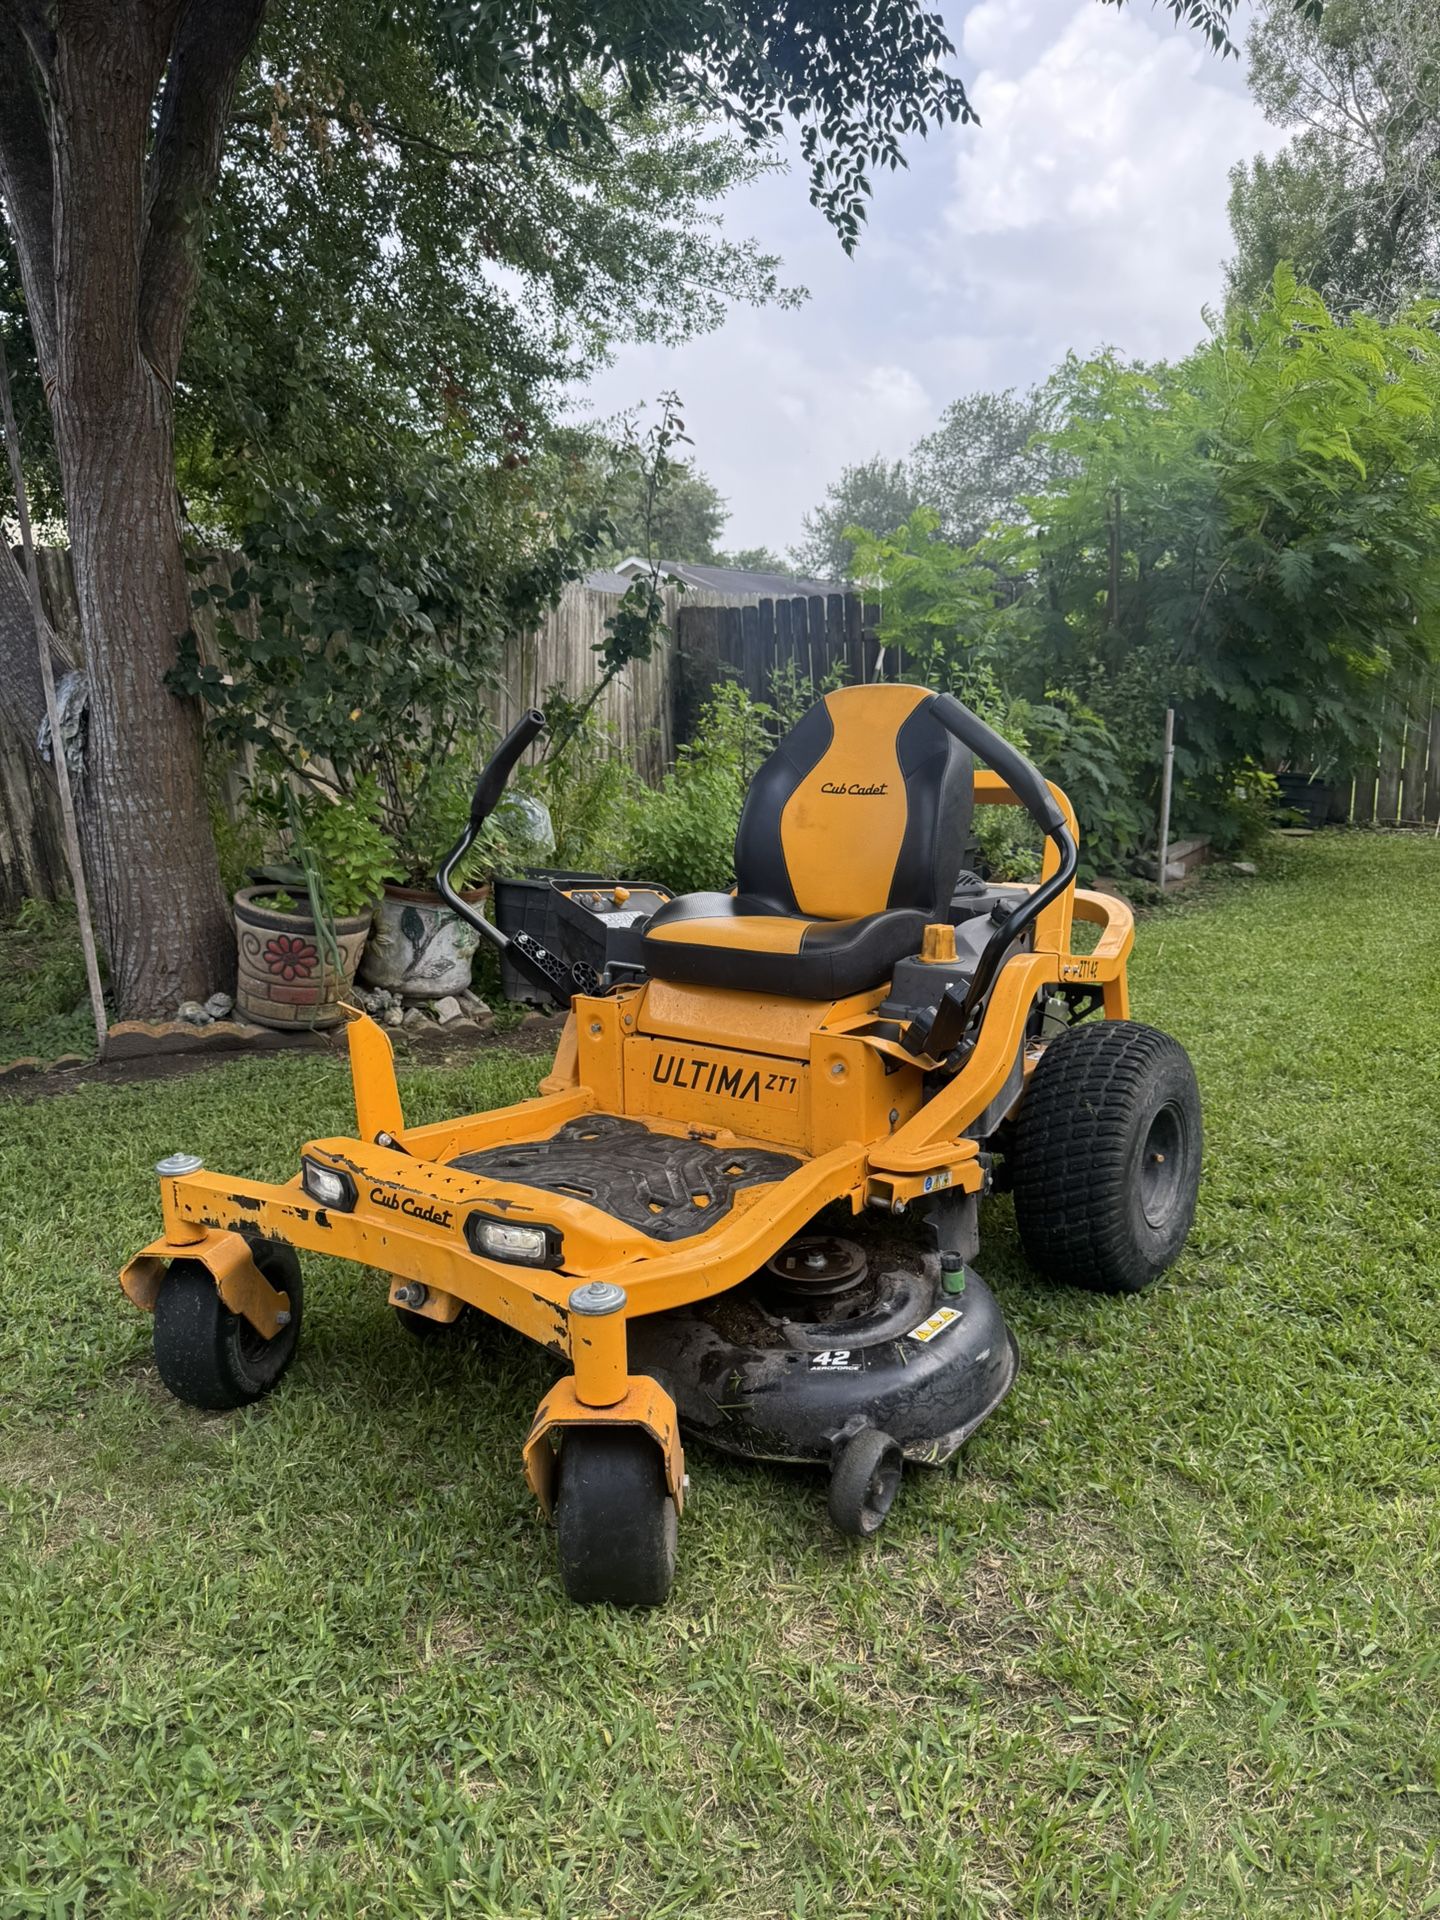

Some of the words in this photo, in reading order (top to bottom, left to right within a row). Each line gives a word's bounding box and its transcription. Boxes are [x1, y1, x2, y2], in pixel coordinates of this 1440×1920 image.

[821, 782, 847, 795] Cub
[847, 783, 888, 795] Cadet
[652, 1053, 760, 1102] ULTIMA
[764, 1073, 797, 1094] ZT1
[369, 1187, 400, 1211] Cub
[401, 1197, 453, 1228] Cadet
[812, 1350, 851, 1366] 42
